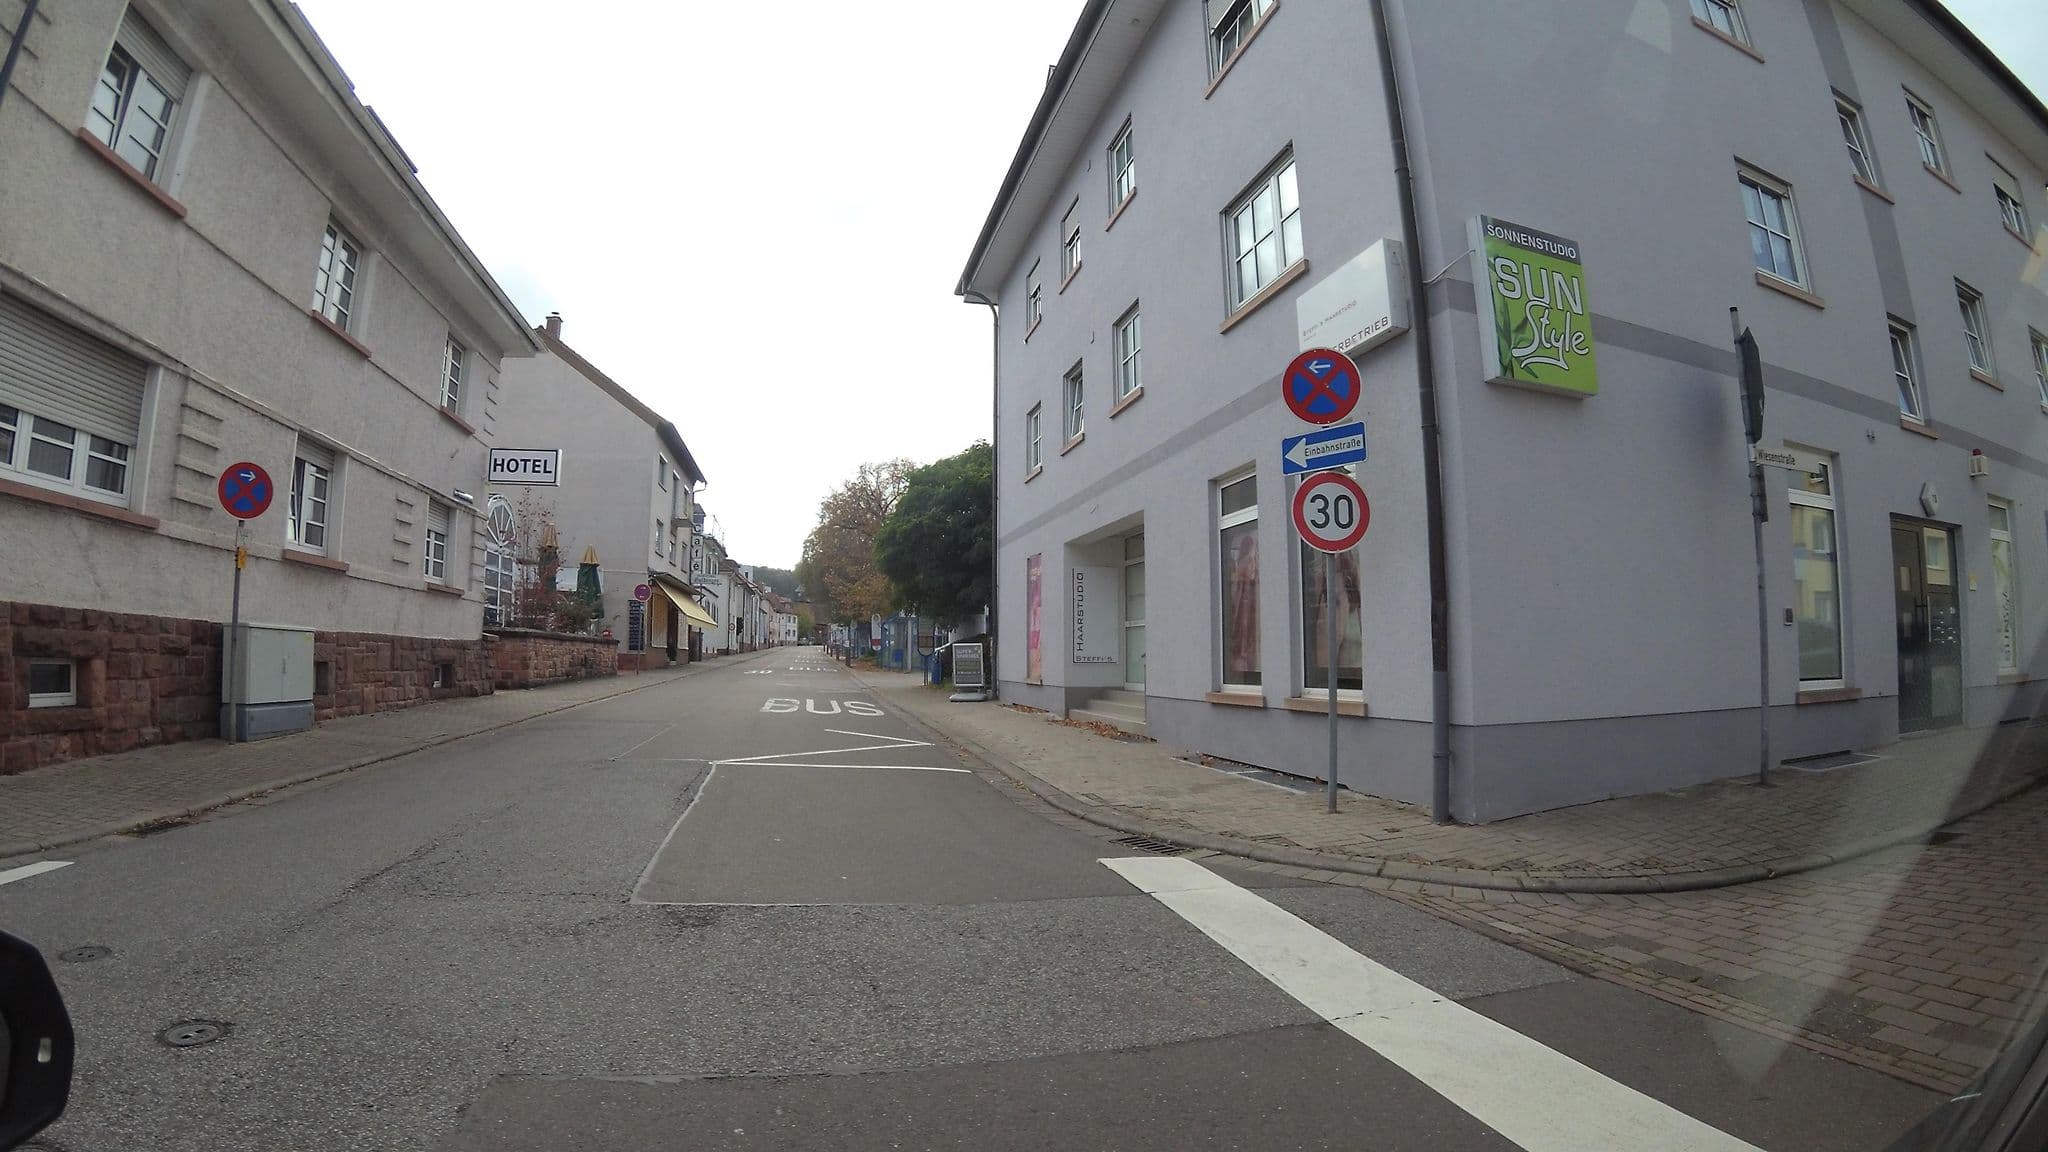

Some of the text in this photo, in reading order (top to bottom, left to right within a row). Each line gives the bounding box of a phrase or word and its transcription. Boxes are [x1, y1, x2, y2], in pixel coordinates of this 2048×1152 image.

[1487, 224, 1577, 259] SONNENSTUDIO
[1494, 256, 1584, 315] SUN
[1511, 300, 1590, 371] Style
[492, 458, 552, 473] HOTEL
[1304, 438, 1361, 457] Einbahnstraße
[1310, 493, 1354, 530] 30
[1076, 572, 1084, 652] HAARSTUDIO
[760, 698, 885, 717] BUS
